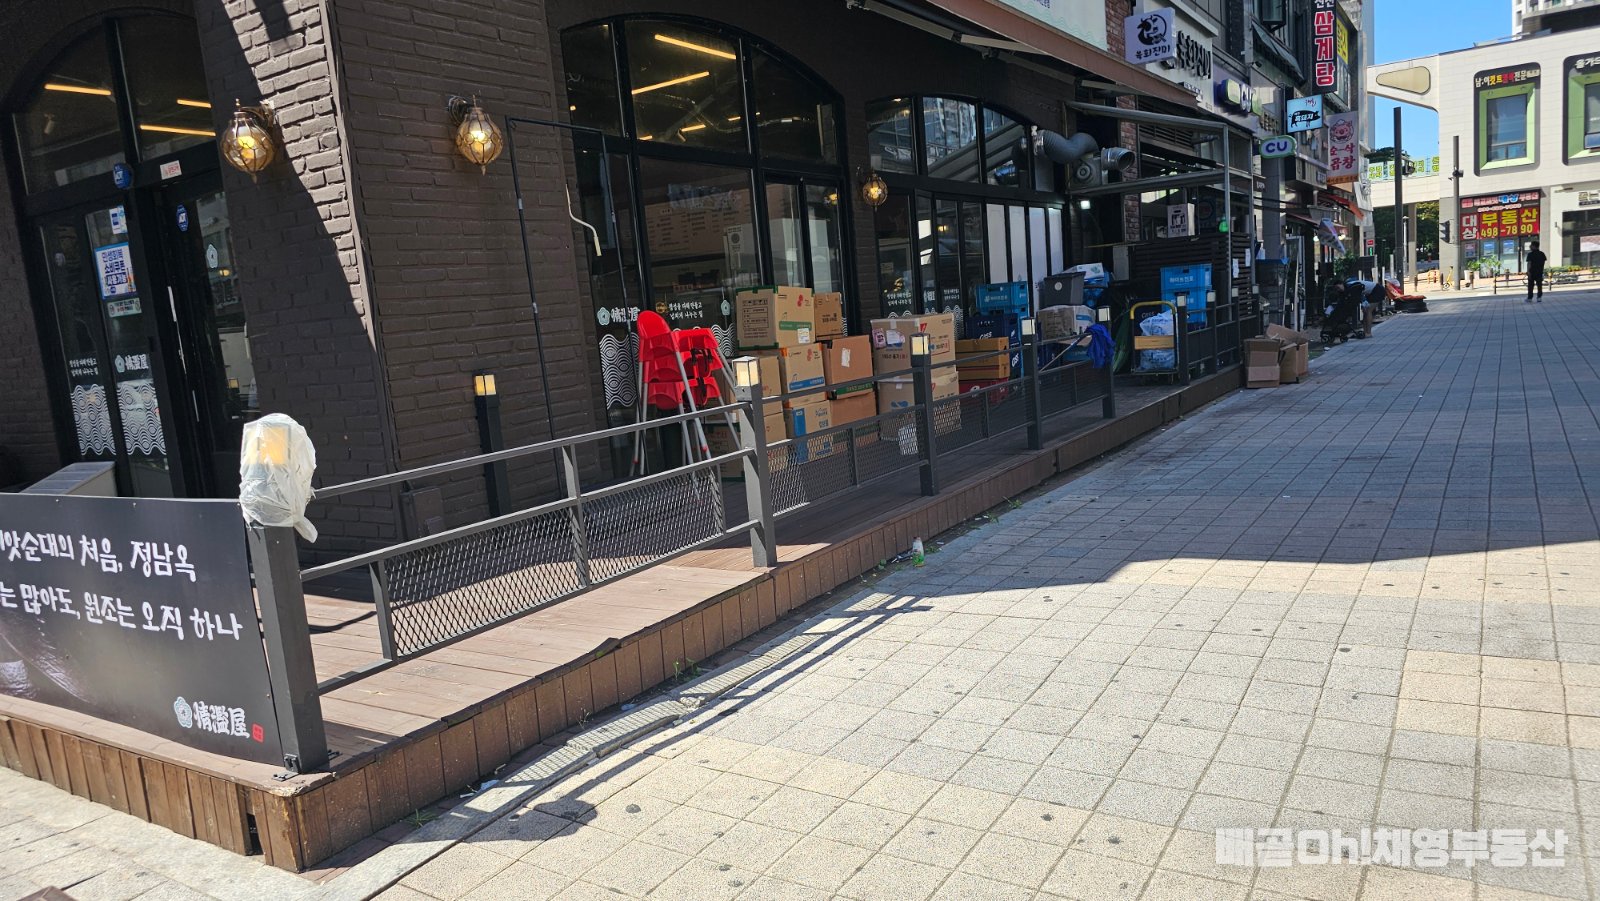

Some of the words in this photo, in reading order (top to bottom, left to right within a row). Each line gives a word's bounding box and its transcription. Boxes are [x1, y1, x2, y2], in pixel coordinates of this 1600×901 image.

[1314, 10, 1336, 87] 삼계탕
[1265, 141, 1288, 153] CU
[1462, 214, 1479, 240] 대상
[1481, 208, 1538, 226] 부동산
[1481, 223, 1533, 238] 498-7890
[79, 534, 123, 573] 처음,
[130, 540, 197, 582] 정남옥
[20, 583, 80, 620] 많아도,
[84, 591, 137, 629] 원조는
[141, 601, 185, 641] 오직
[189, 607, 244, 641] 하나
